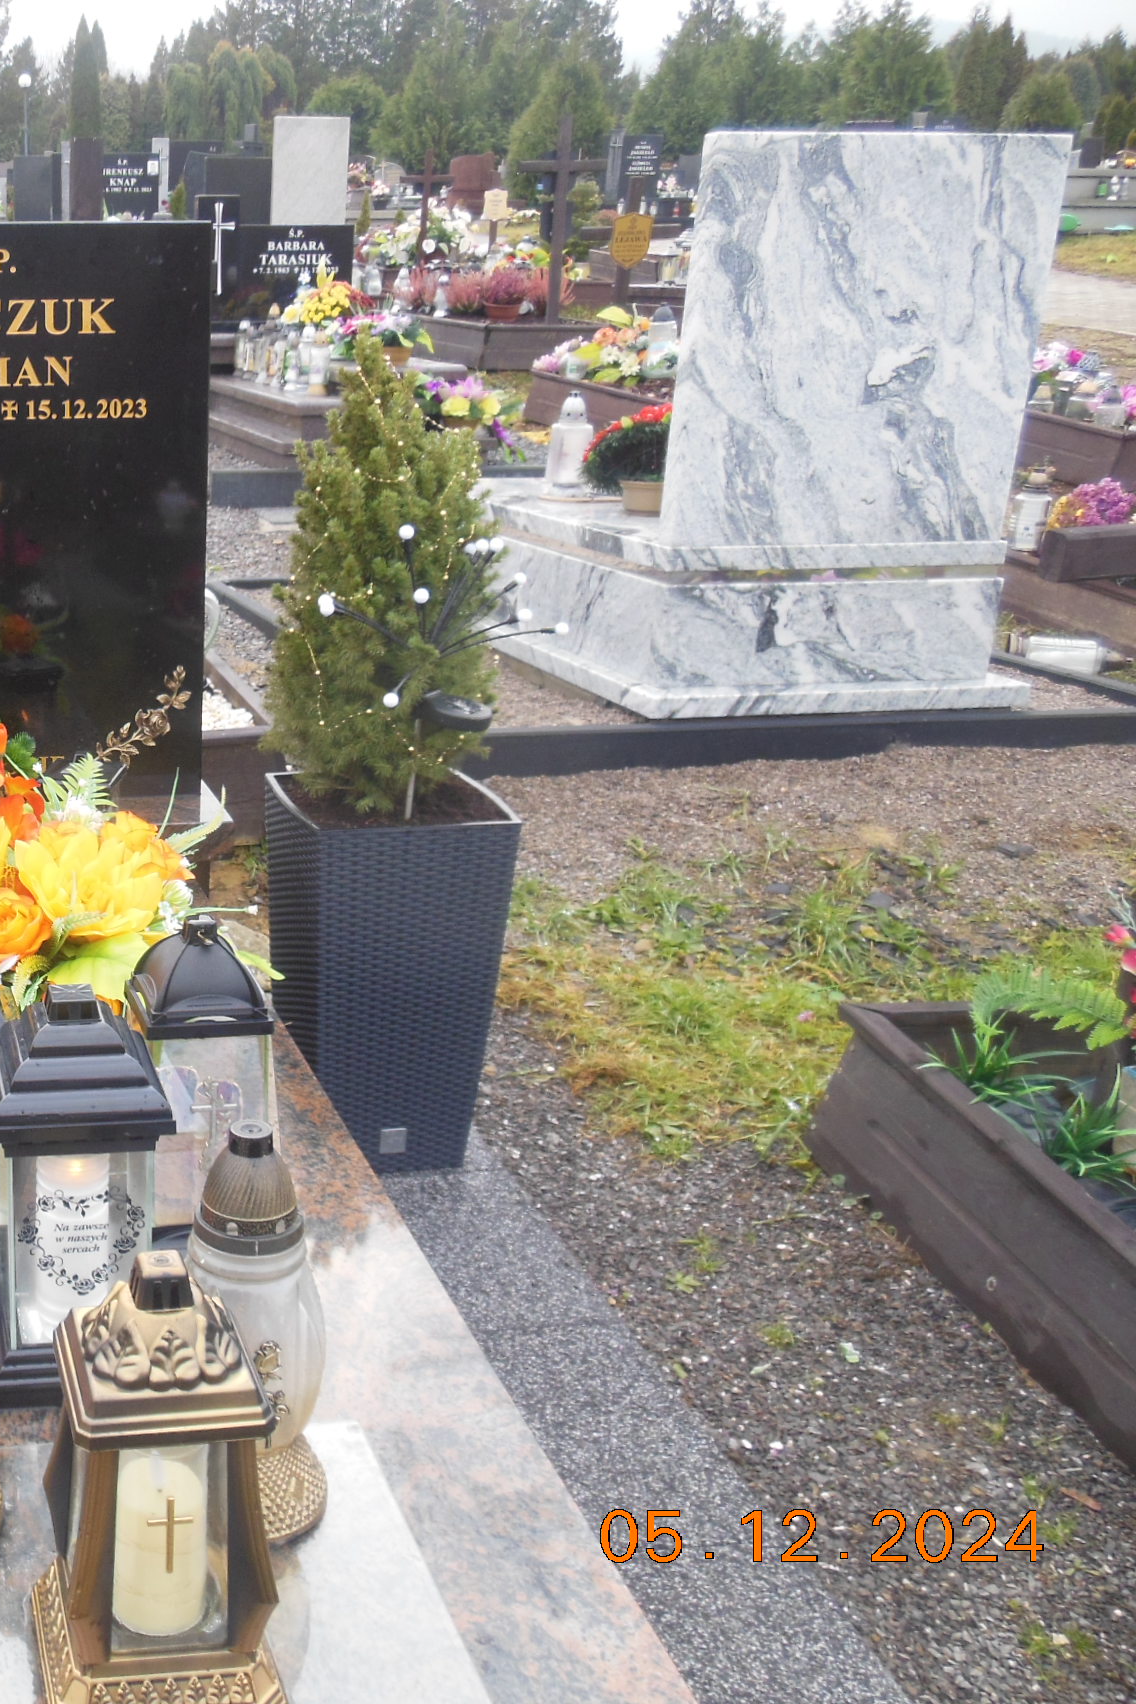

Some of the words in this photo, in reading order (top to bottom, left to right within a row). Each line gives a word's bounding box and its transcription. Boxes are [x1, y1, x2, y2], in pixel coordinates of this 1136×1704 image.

[109, 178, 137, 186] KNAP
[288, 227, 305, 238] Ś.P.
[267, 241, 325, 251] BARBARA
[259, 253, 333, 266] TARASIUK
[26, 398, 148, 420] 15.12.2023
[54, 1223, 69, 1232] Na
[73, 1223, 110, 1231] zawsze
[67, 1232, 108, 1244] naszych
[63, 1244, 100, 1254] sercach
